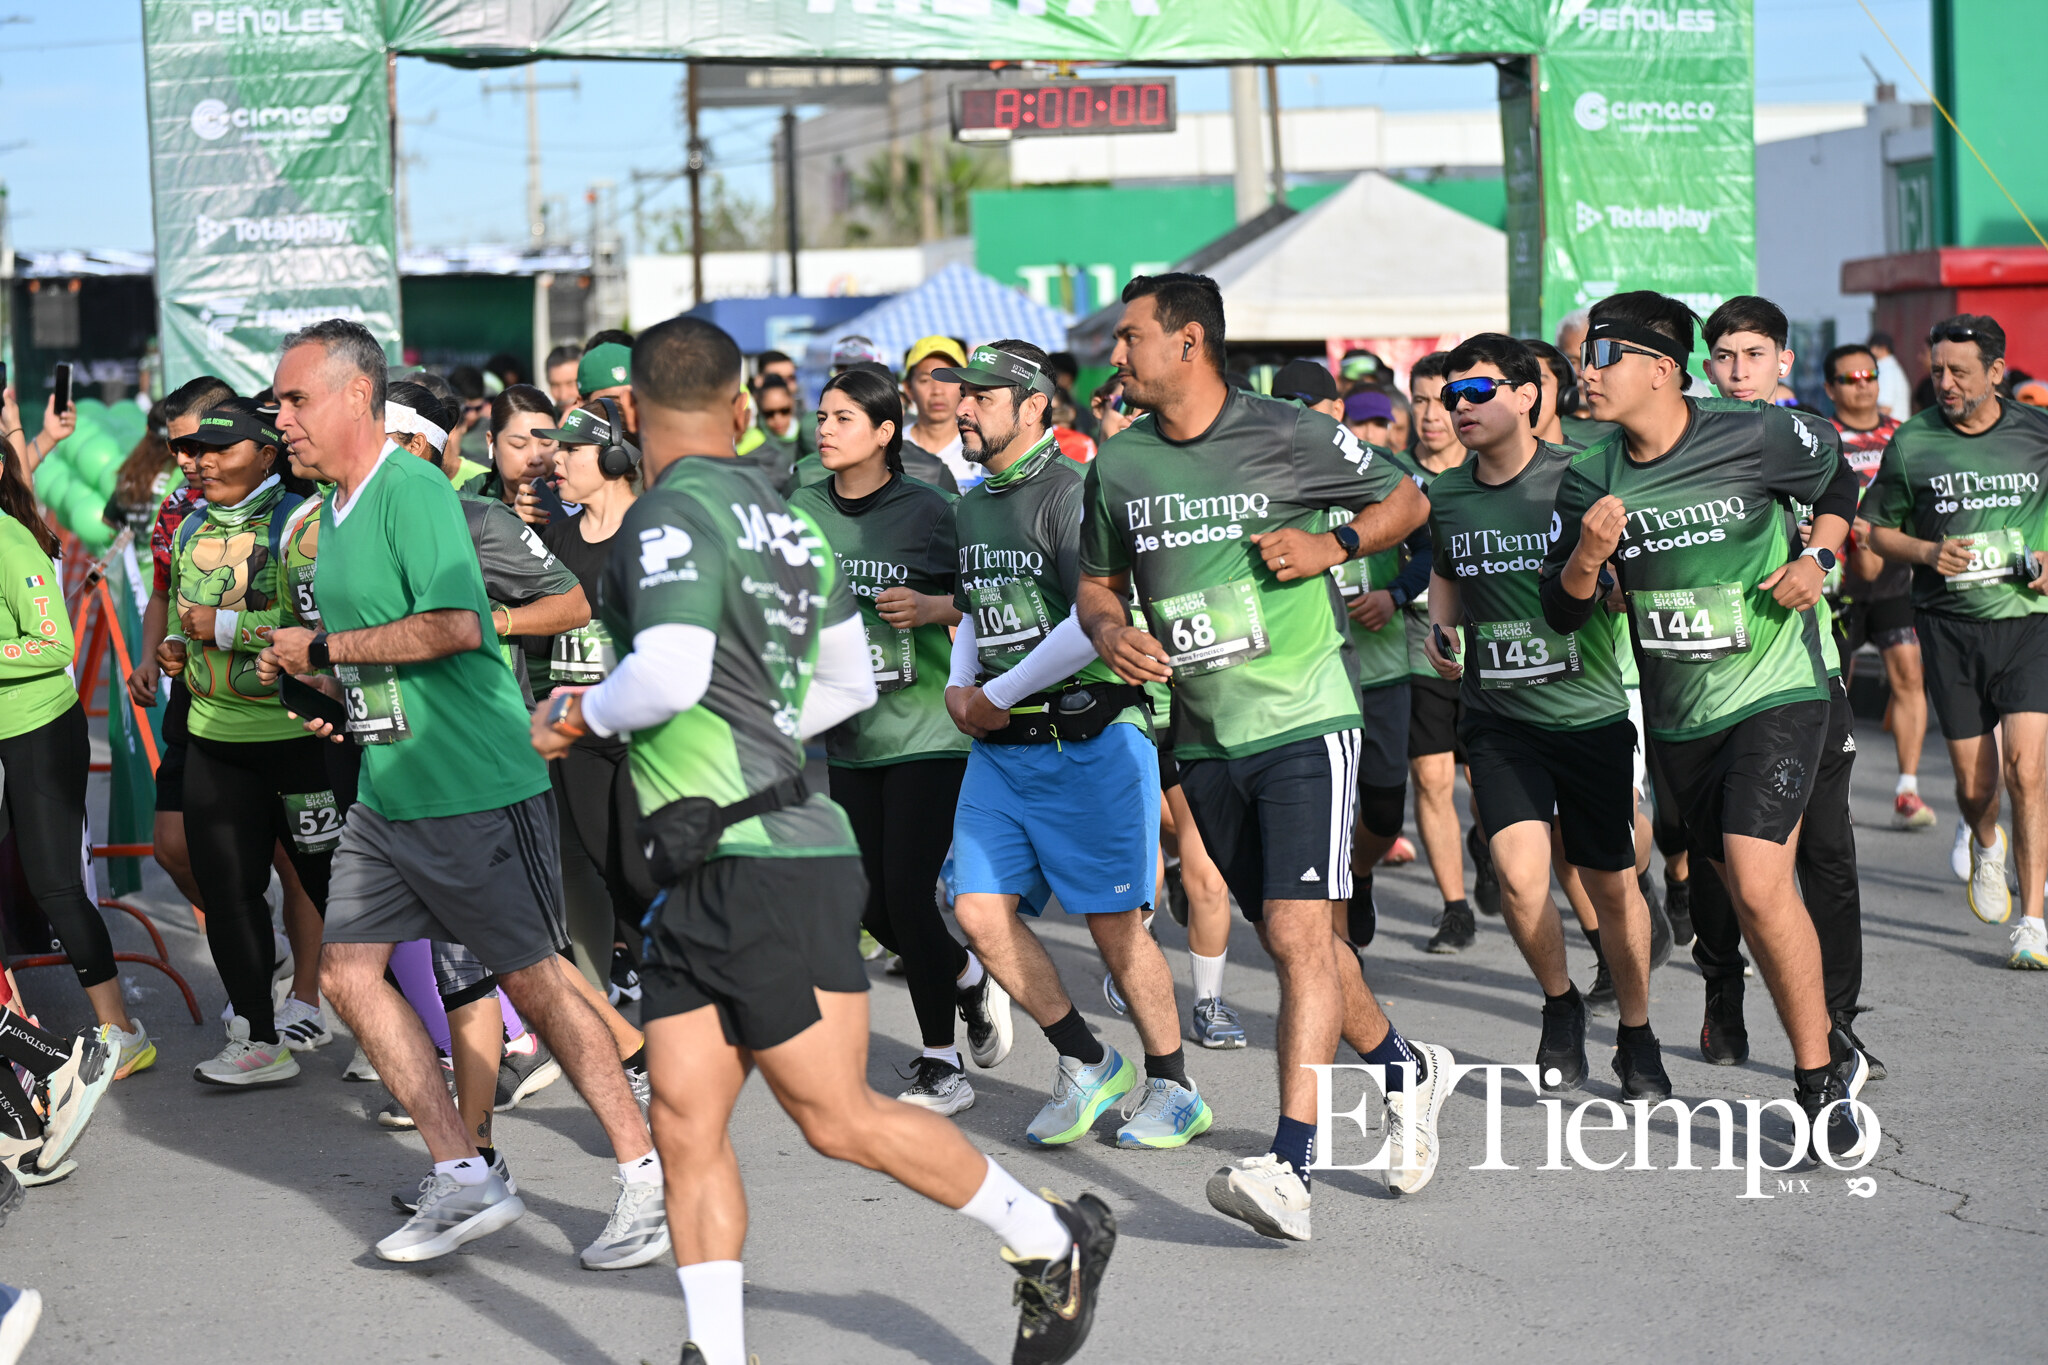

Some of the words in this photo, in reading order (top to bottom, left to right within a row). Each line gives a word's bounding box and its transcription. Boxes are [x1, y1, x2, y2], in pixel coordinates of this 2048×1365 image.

[231, 214, 348, 244] Totalplay
[1605, 205, 1713, 234] Totalplay
[1929, 473, 1955, 498] El
[1955, 471, 2040, 494] Tiempo
[1125, 497, 1152, 531] El
[1155, 492, 1270, 523] Tiempo
[1626, 496, 1745, 535] Tiempo
[1935, 499, 1959, 514] de
[1961, 494, 2022, 510] todos
[1135, 534, 1159, 554] de
[1161, 524, 1243, 548] todos
[1451, 532, 1472, 559] El
[1643, 528, 1726, 553] todos
[959, 546, 968, 574] El
[970, 543, 1043, 575] Tiempo
[1455, 562, 1479, 577] de
[1652, 591, 1695, 599] CARRERA
[978, 603, 1022, 636] 104
[1030, 590, 1051, 636] MEDALLA
[1244, 596, 1266, 650] MEDALLA
[1492, 621, 1531, 630] CARRERA
[1648, 609, 1715, 639] 144
[1732, 599, 1747, 648] MEDALLA
[1172, 613, 1216, 652] 68
[560, 635, 601, 662] 112
[902, 638, 912, 682] MEDALLA
[1487, 637, 1549, 669] 143
[1566, 631, 1580, 672] MEDALL
[345, 687, 369, 719] 63
[387, 678, 406, 731] MEDALLA
[299, 807, 342, 836] 52
